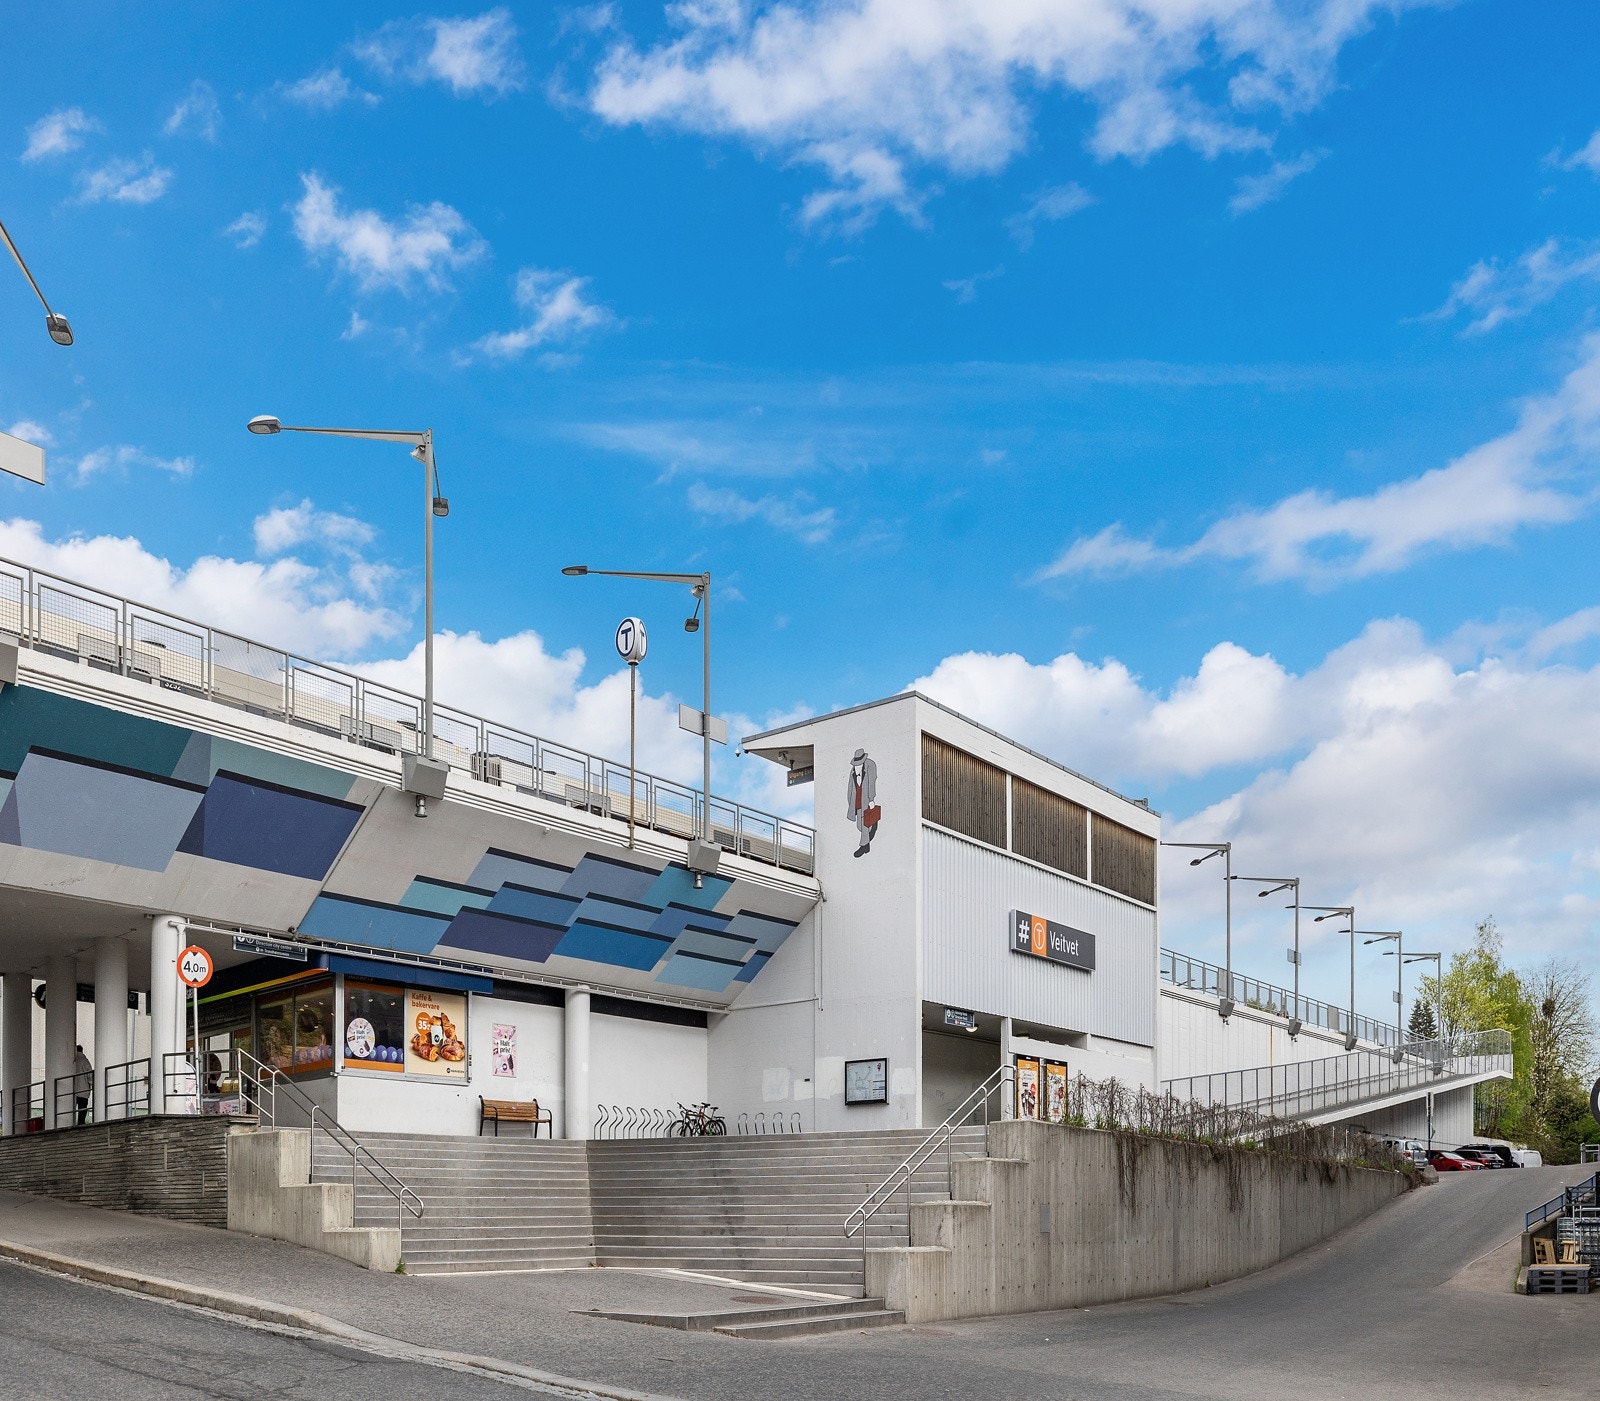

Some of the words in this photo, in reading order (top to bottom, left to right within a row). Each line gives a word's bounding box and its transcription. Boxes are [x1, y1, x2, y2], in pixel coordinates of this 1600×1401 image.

[621, 626, 632, 651] T
[1049, 930, 1079, 957] Veitvet
[411, 992, 428, 1001] Kaffe
[411, 1000, 440, 1011] bakervare
